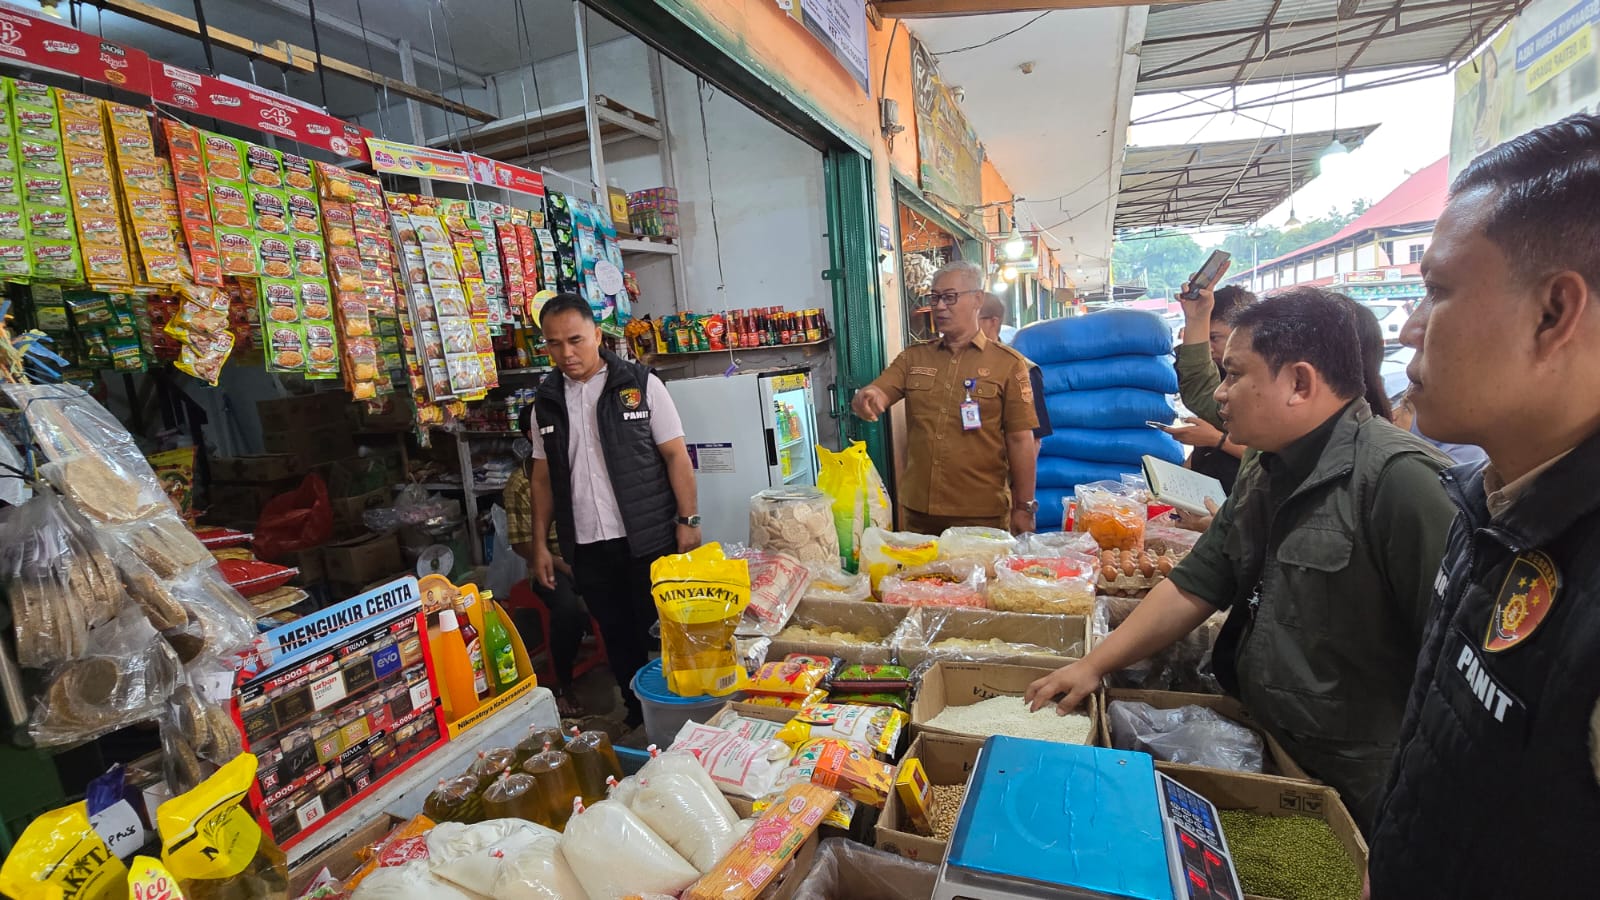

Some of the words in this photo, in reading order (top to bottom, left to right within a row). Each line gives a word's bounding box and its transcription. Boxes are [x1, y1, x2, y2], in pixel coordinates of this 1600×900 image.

[100, 43, 124, 56] SAORI
[623, 410, 649, 421] PANIT
[659, 587, 740, 605] MINYAKITA
[278, 604, 363, 655] MENGUKIR
[366, 583, 412, 616] CERITA
[376, 652, 398, 669] evo
[313, 676, 337, 691] urban
[315, 685, 333, 697] mild
[1456, 644, 1513, 723] PANIT
[457, 703, 493, 730] Nikmatnya
[263, 784, 294, 806] 15.000
